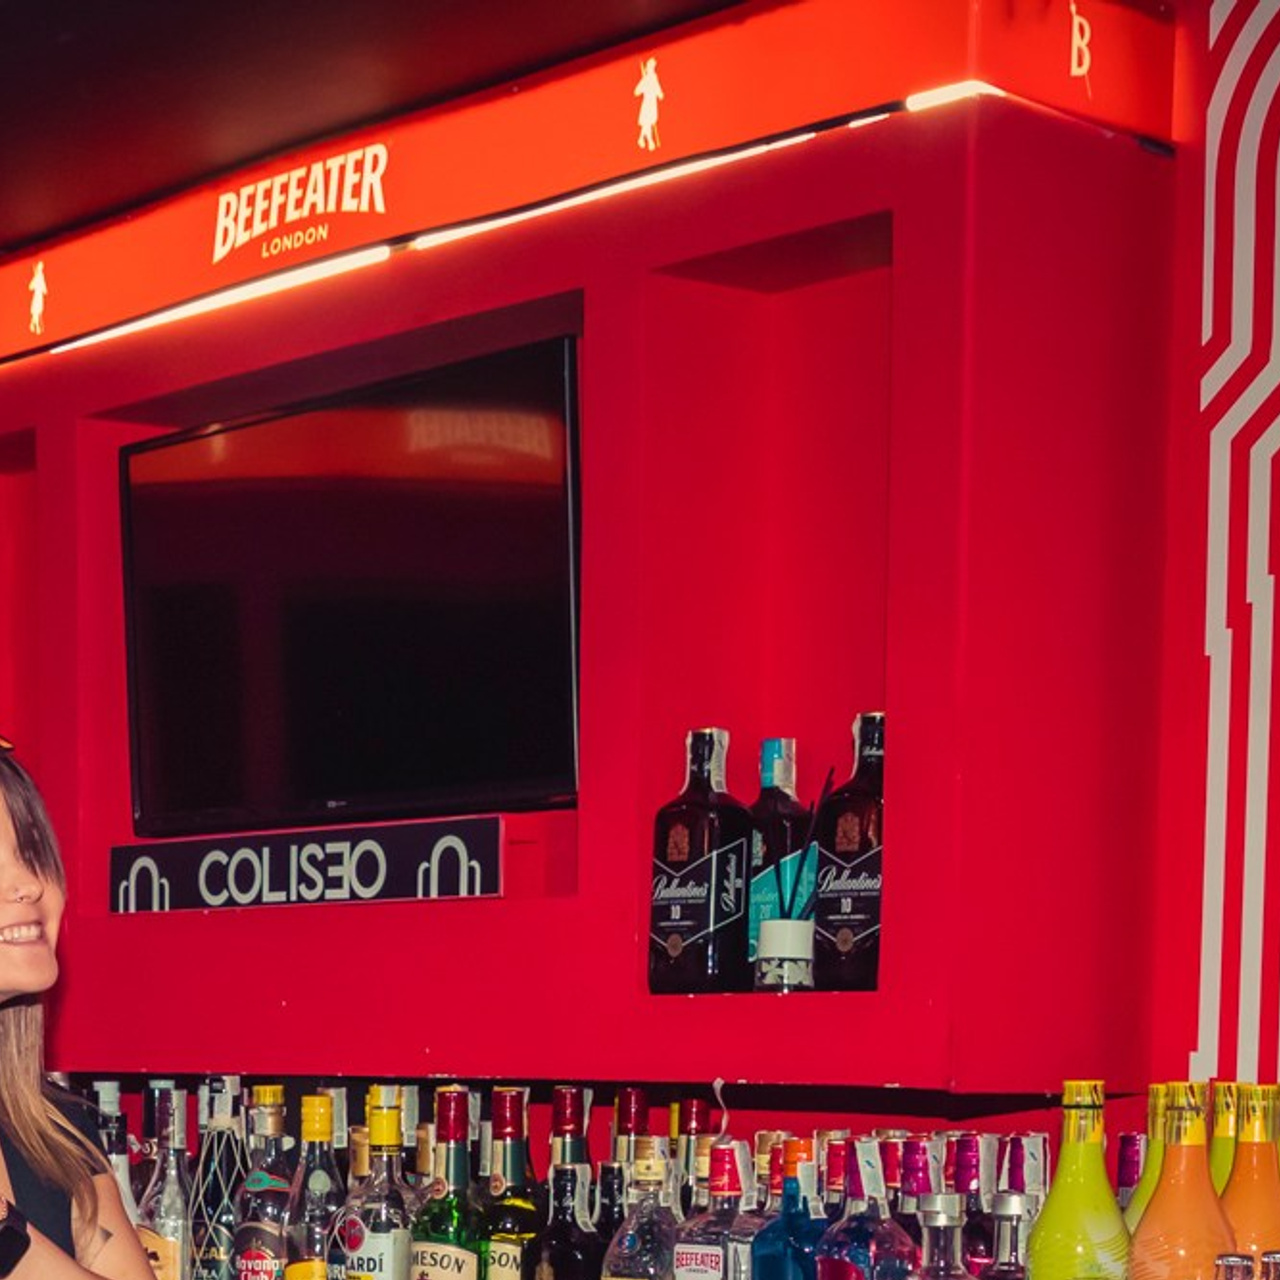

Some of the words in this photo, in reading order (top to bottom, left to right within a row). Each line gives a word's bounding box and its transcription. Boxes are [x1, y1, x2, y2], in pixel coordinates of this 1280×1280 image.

[1070, 14, 1091, 77] B
[212, 143, 389, 264] BEEFEATER
[261, 224, 329, 258] LONDON
[198, 839, 387, 906] COLISEO
[675, 1251, 721, 1272] BEEFEATER
